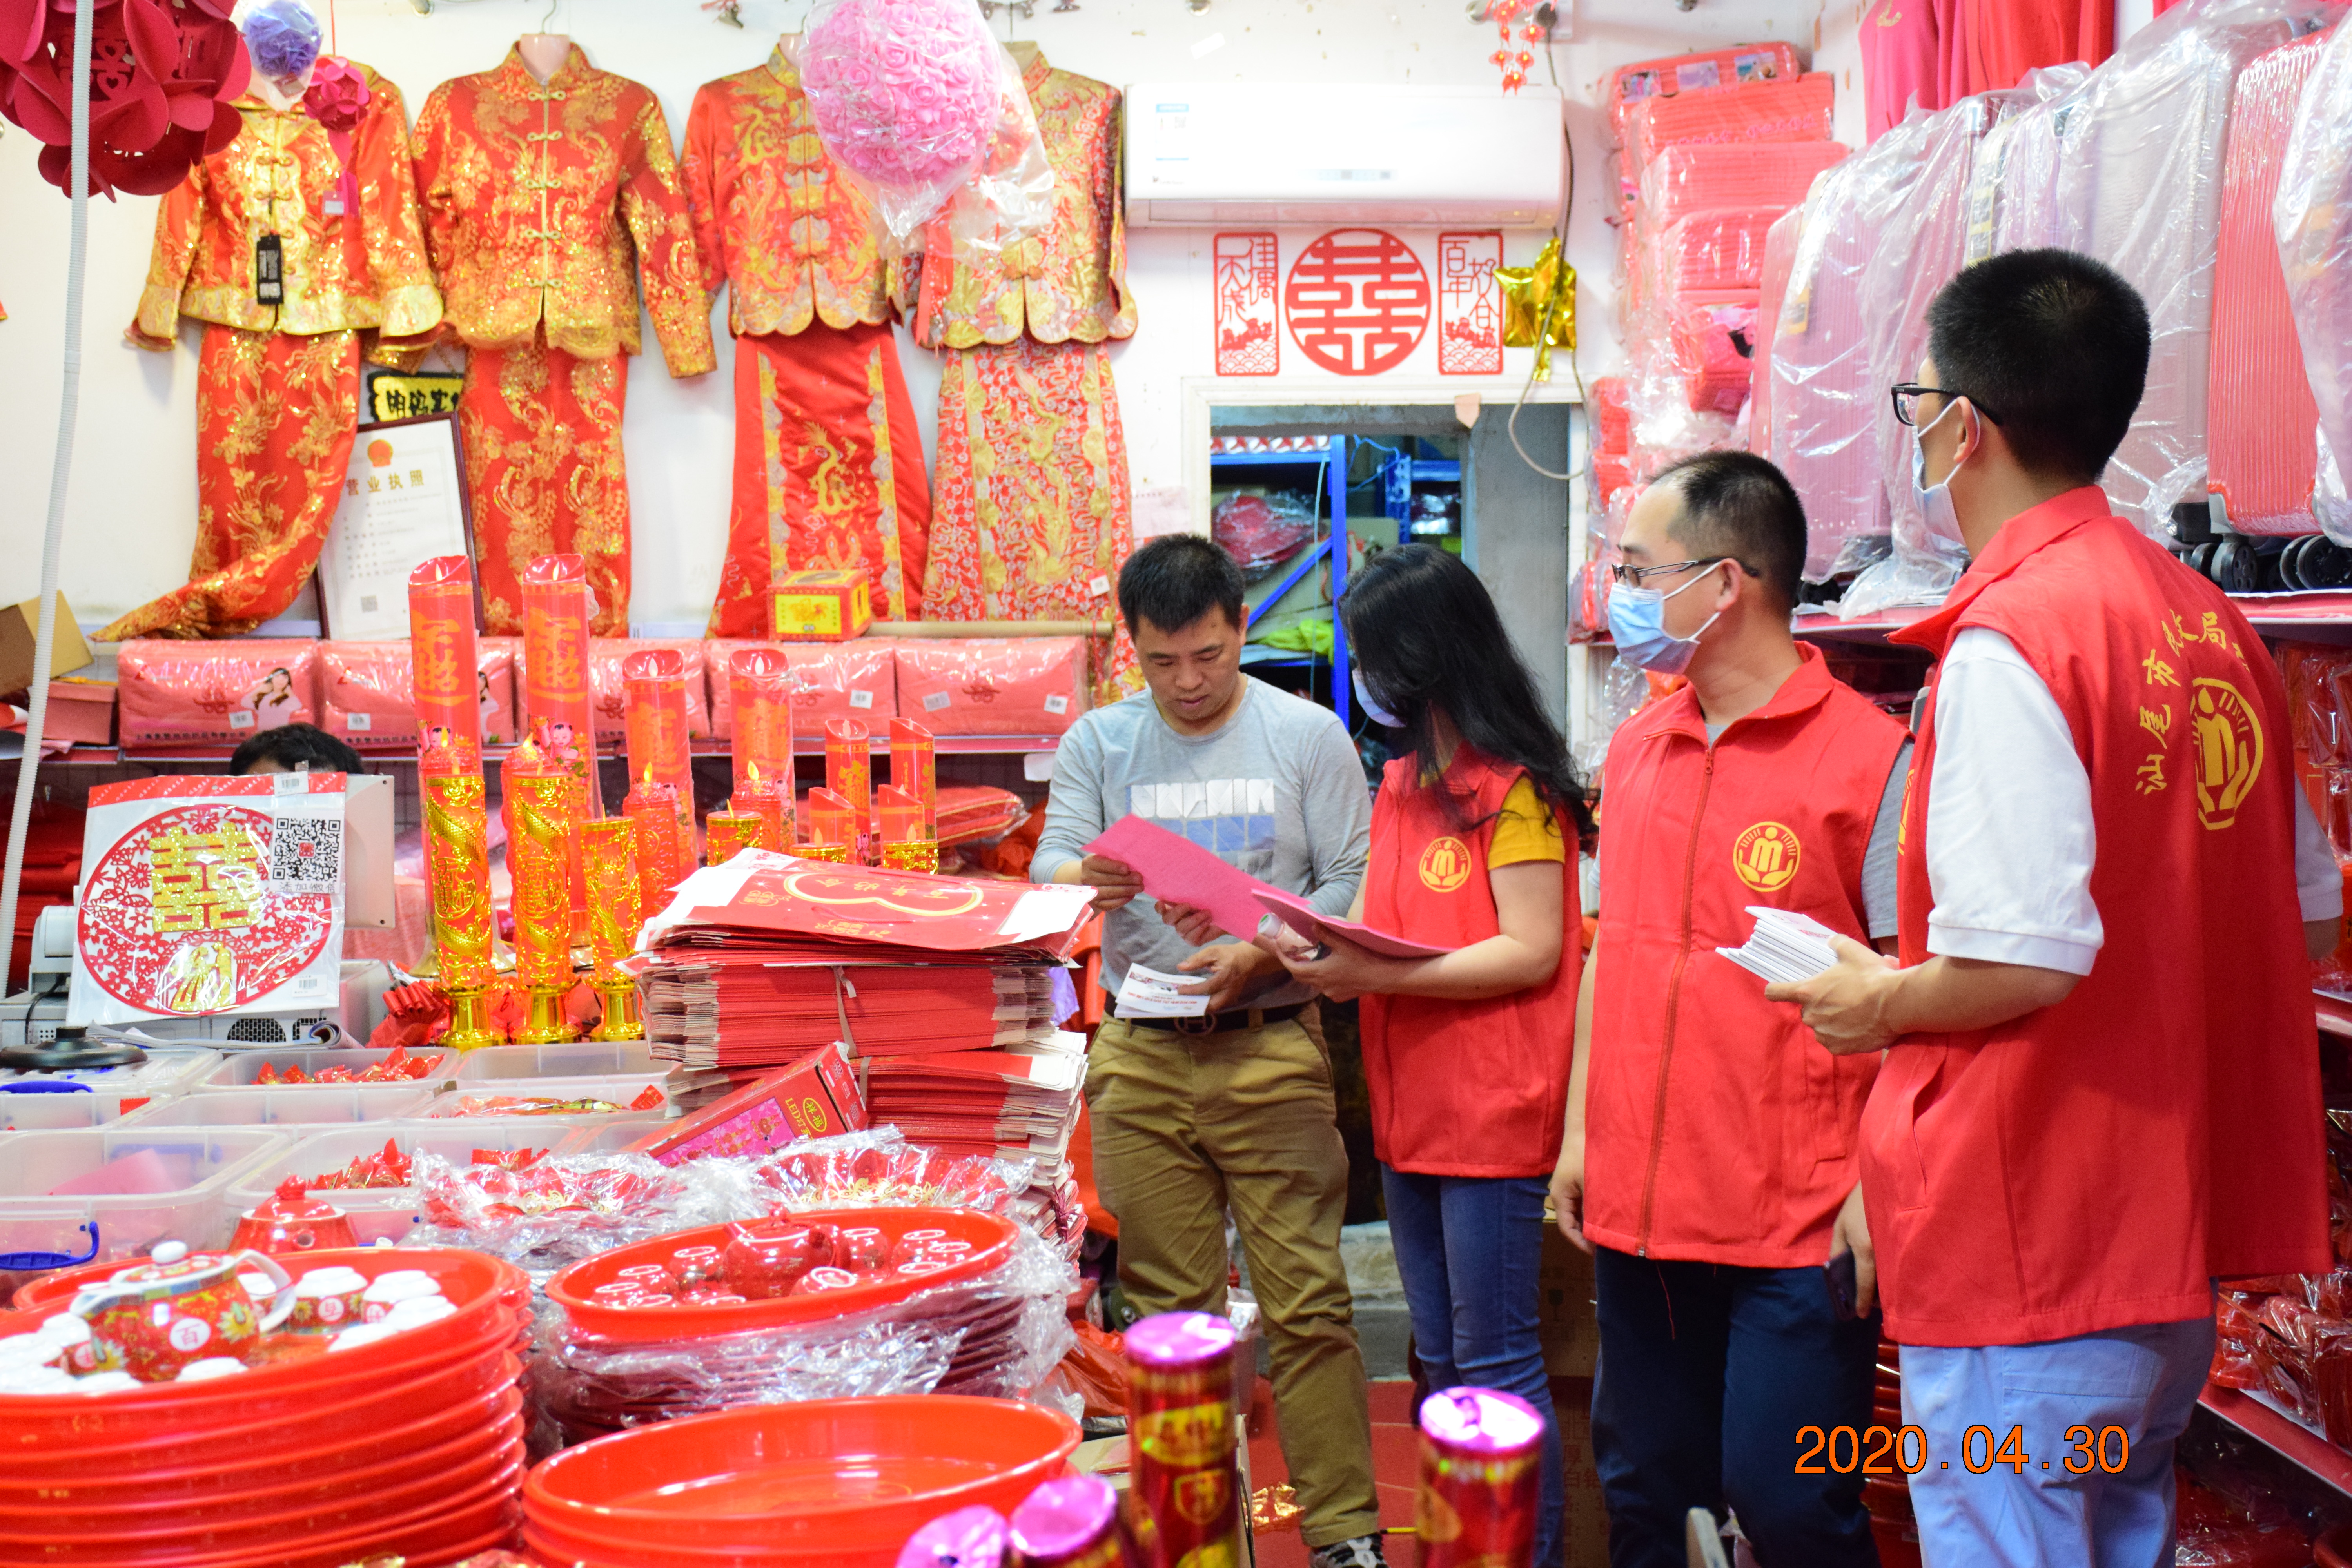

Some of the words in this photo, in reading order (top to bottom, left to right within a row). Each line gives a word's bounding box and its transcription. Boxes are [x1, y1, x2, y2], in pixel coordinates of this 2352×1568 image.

[346, 469, 424, 497] 营业执照
[279, 881, 336, 893] 添加微信
[806, 1102, 824, 1128] 祥福
[176, 1323, 201, 1347] 百
